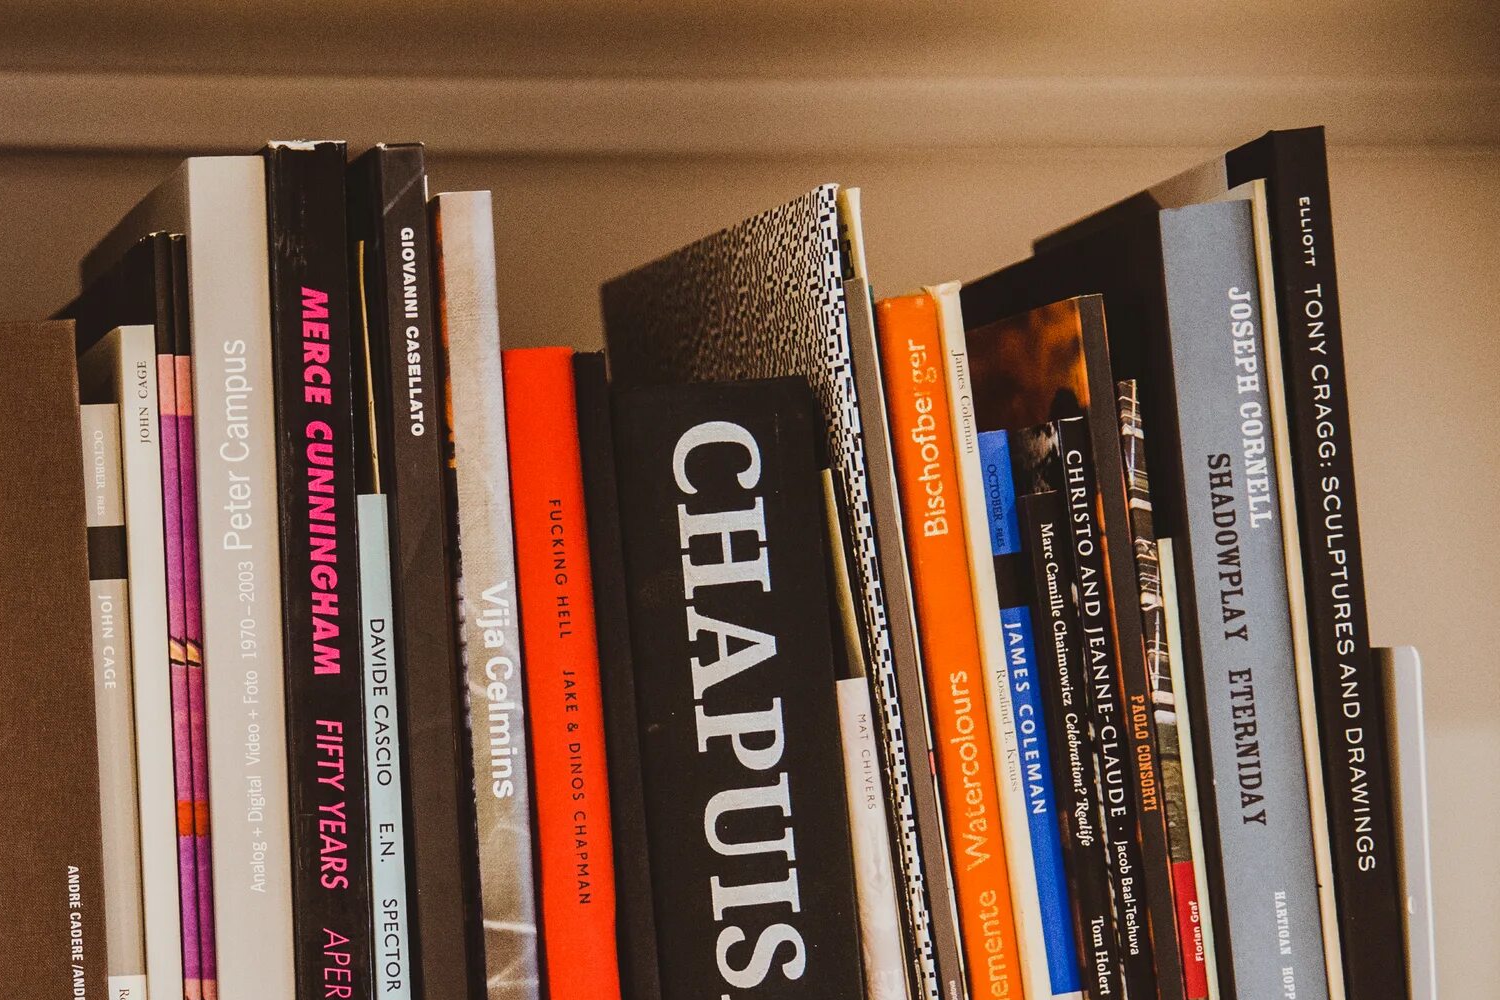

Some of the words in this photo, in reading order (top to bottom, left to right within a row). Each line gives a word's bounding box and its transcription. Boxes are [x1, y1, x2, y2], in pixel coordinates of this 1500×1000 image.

[1299, 197, 1316, 266] ELLIOTT
[400, 227, 418, 319] GIOVANNI
[301, 286, 332, 404] MERCE
[1228, 287, 1260, 394] JOSEPH
[1304, 284, 1326, 354] TONY
[406, 326, 424, 436] CASELLATO
[1310, 364, 1336, 467] CRAGG:
[1066, 450, 1093, 556] CHRISTO
[1238, 401, 1272, 528] CORNELL
[306, 420, 340, 675] CUNNINGHAM
[548, 499, 569, 585] FUCKING
[1040, 523, 1054, 560] Marc
[1321, 476, 1354, 655] SCULPTURES
[99, 595, 114, 638] JOHN
[476, 581, 511, 648] Vija
[557, 596, 572, 639] HELL
[1046, 562, 1060, 617] Camille
[1080, 567, 1101, 617] AND
[103, 646, 117, 689] CAGE
[370, 618, 390, 697] DAVIDE
[1051, 620, 1075, 706] Chaimowicz
[1207, 453, 1248, 642] SHADOWPLAY
[1228, 669, 1266, 827] ETERNIDAY
[483, 657, 516, 798] Celmins
[563, 670, 578, 713] JAKE
[568, 723, 579, 732] &
[1006, 622, 1030, 693] JAMES
[1019, 705, 1047, 815] COLEMAN
[1084, 627, 1127, 818] JEANNE-CLAUDE
[1131, 695, 1150, 739] PAOLO
[1338, 663, 1361, 719] AND
[315, 719, 345, 792] FIFTY
[375, 704, 393, 786] CASCIO
[569, 743, 584, 801] DINOS
[949, 671, 992, 871] Watercolours
[1064, 712, 1087, 796] Celebration?
[1137, 744, 1157, 811] CONSORTI
[1345, 728, 1376, 872] DRAWINGS
[319, 801, 348, 890] YEARS
[379, 823, 395, 863] E.N.
[573, 811, 590, 905] CHAPMAN
[1113, 840, 1133, 874] Jacob
[70, 913, 85, 961] CADERE
[383, 899, 401, 993] SPECTOR
[1090, 916, 1106, 946] Tom
[1119, 877, 1140, 955] Baal-Teshuva
[1274, 891, 1292, 955] HARTIGAN
[1094, 950, 1112, 995] Holert
